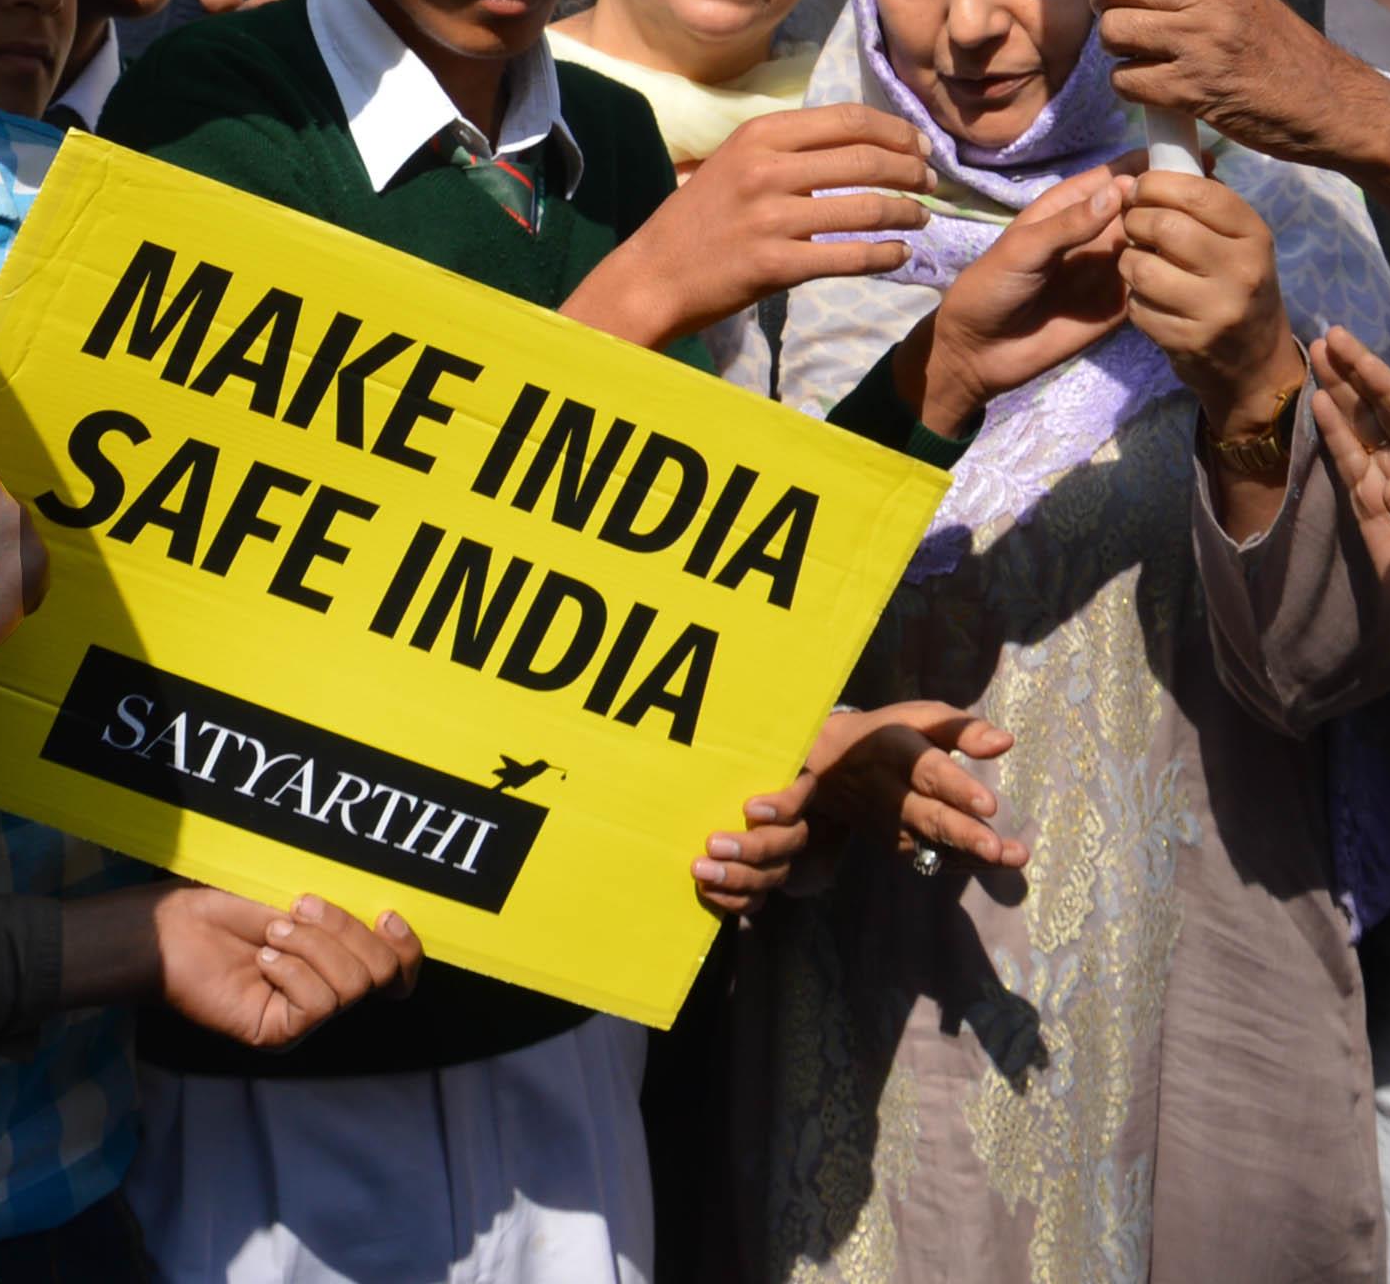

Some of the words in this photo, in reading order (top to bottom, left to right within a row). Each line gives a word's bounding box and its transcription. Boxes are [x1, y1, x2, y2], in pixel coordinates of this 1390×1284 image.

[31, 408, 380, 614] SAFE
[367, 521, 720, 747] INDIA
[80, 239, 485, 475] MAKE
[470, 382, 820, 611] INDIA
[100, 692, 499, 875] SATYARTHI
